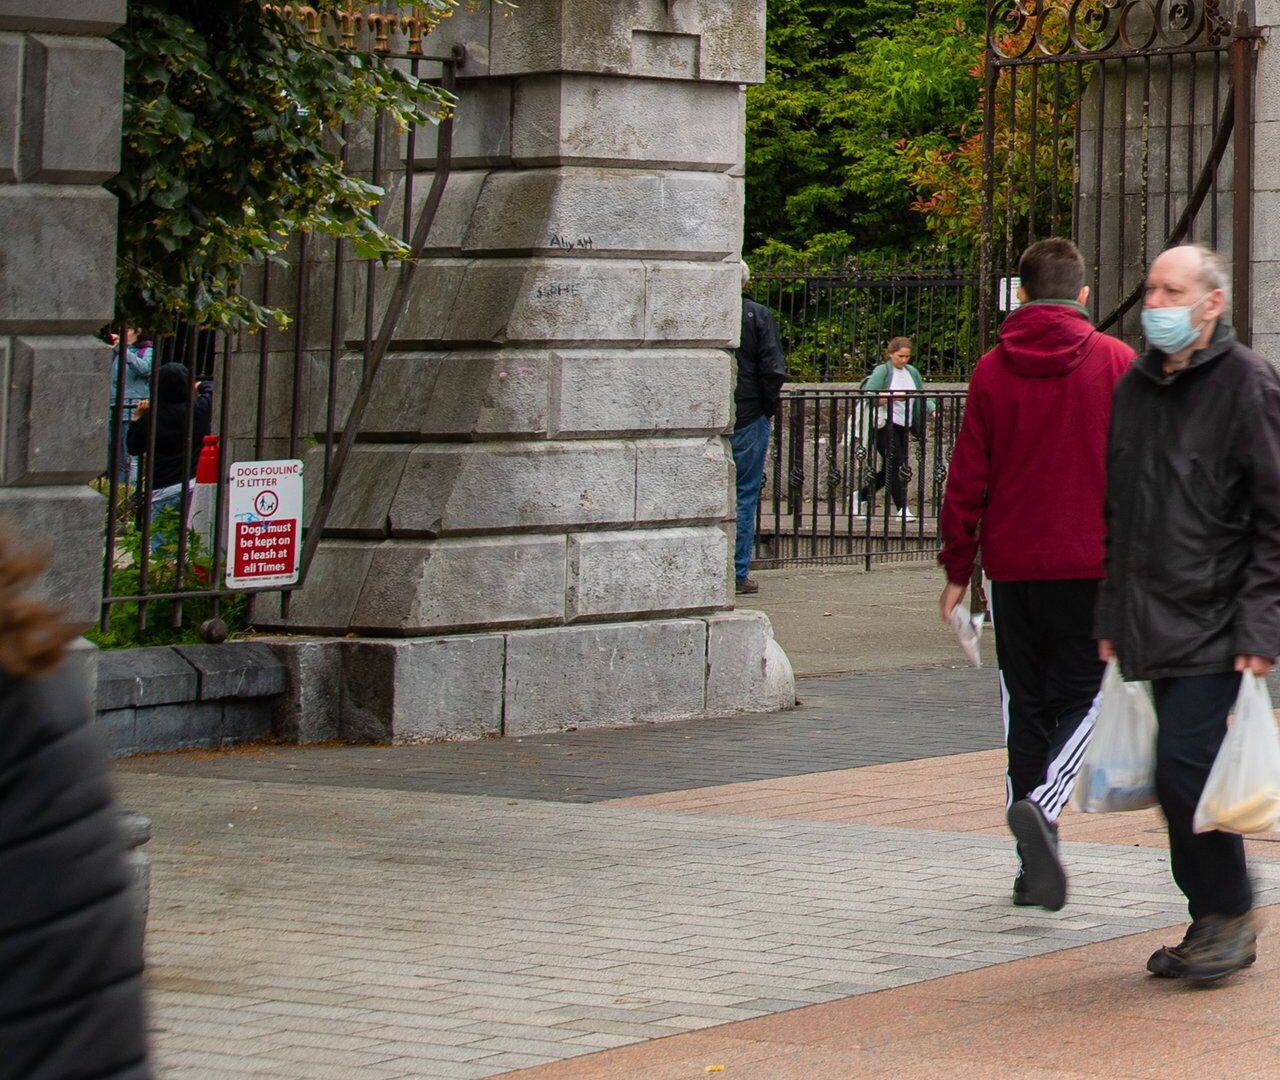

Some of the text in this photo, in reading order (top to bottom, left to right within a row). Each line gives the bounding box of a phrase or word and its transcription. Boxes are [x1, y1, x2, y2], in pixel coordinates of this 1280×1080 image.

[237, 467, 259, 477] DOG
[237, 477, 277, 488] IS LITTER
[240, 522, 292, 536] Dogs must
[240, 536, 290, 548] be kept on
[242, 549, 288, 561] a leash at
[243, 562, 286, 573] all Times
